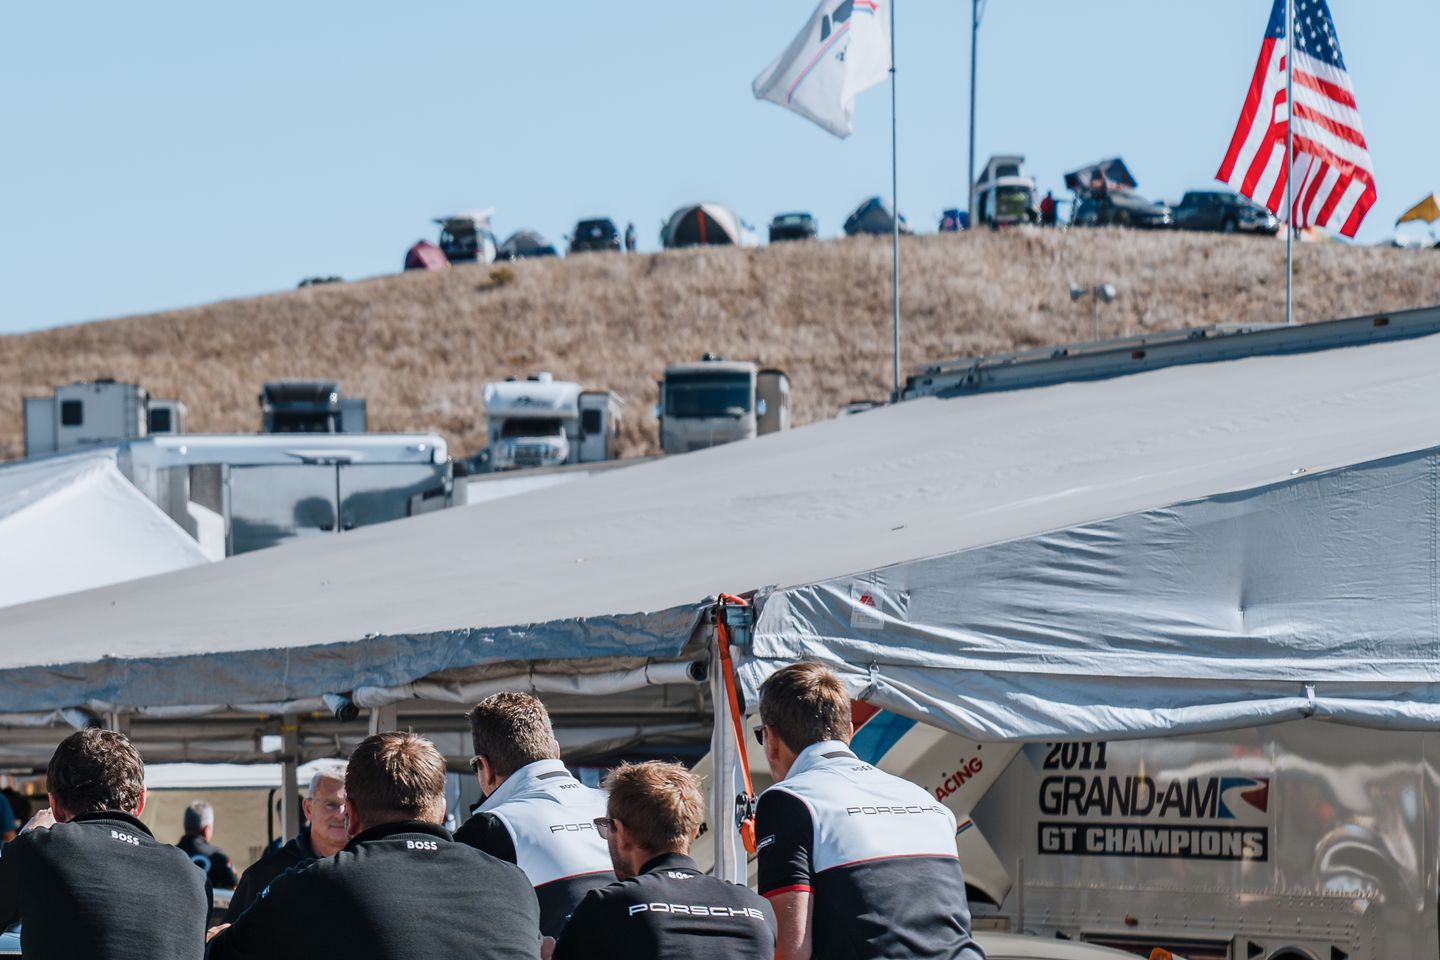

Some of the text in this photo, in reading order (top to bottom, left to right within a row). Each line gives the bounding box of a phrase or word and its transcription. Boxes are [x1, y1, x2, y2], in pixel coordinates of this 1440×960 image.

[1042, 742, 1108, 770] 2011
[935, 757, 983, 803] ACING
[846, 805, 946, 816] PORSCHE
[111, 830, 140, 846] BOSS
[406, 840, 438, 850] BOSS
[1041, 827, 1264, 857] GT CHAMPIONS
[628, 902, 765, 921] PORSCHE
